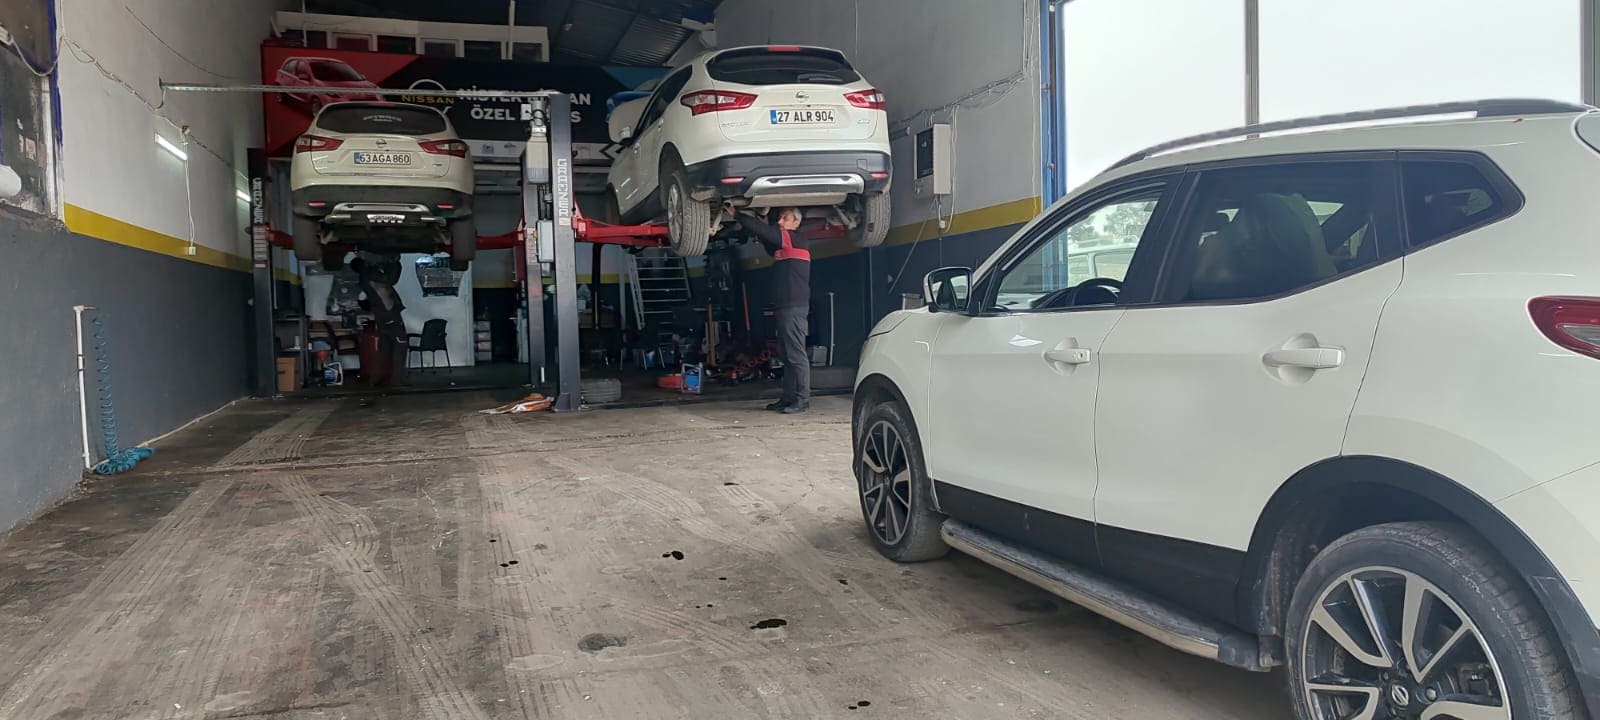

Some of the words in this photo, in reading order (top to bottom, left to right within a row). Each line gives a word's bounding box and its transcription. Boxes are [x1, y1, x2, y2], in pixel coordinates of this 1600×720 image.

[401, 94, 454, 105] NISSAN
[470, 104, 515, 120] ÖZEL
[777, 111, 790, 122] 27
[793, 111, 812, 122] ALR
[815, 110, 833, 122] 904
[372, 154, 391, 163] AGA
[392, 154, 410, 164] 860
